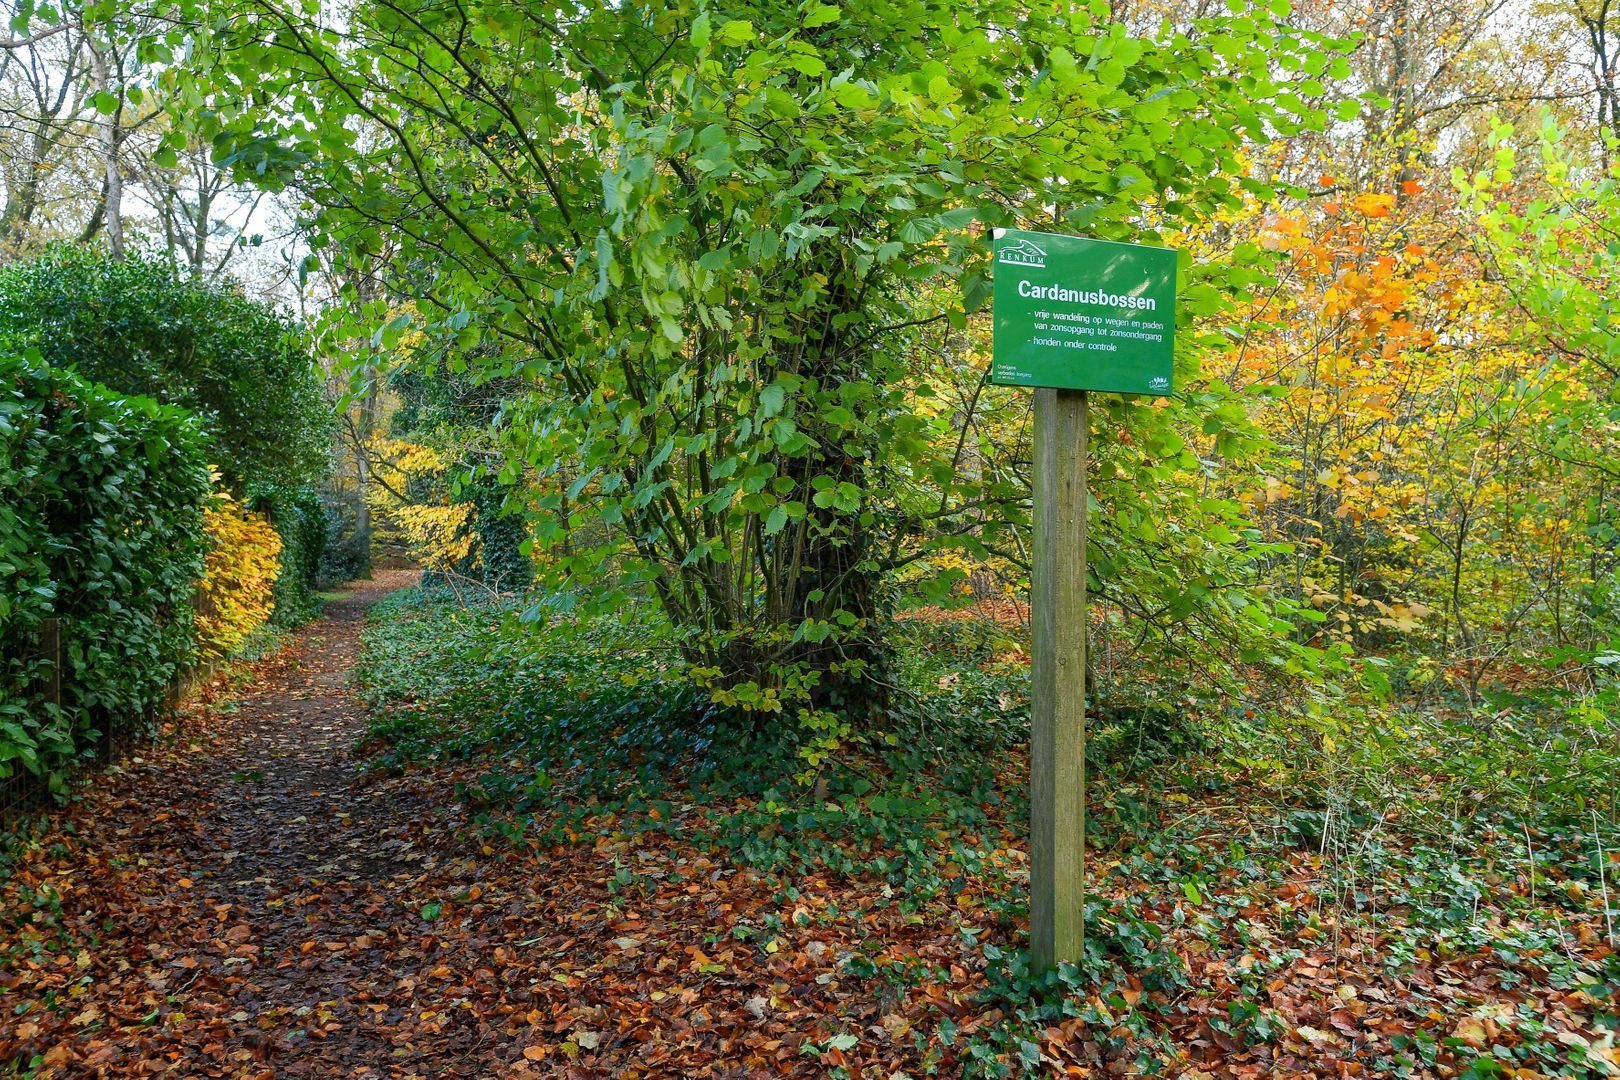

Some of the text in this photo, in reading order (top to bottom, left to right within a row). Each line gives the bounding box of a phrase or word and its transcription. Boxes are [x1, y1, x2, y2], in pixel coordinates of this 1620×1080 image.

[1000, 252, 1044, 264] RENKUM
[1018, 280, 1156, 310] Cardanusbossen
[1034, 310, 1050, 319] vrije
[1053, 313, 1089, 324] wandeling
[1093, 316, 1102, 325] op
[1106, 318, 1129, 327] wegen
[1142, 320, 1163, 330] paden
[1050, 323, 1094, 335] zonsopgang
[1110, 329, 1162, 341] zonsondergang
[1034, 337, 1061, 346] honden
[1064, 340, 1085, 348] onder
[1088, 342, 1117, 351] controle
